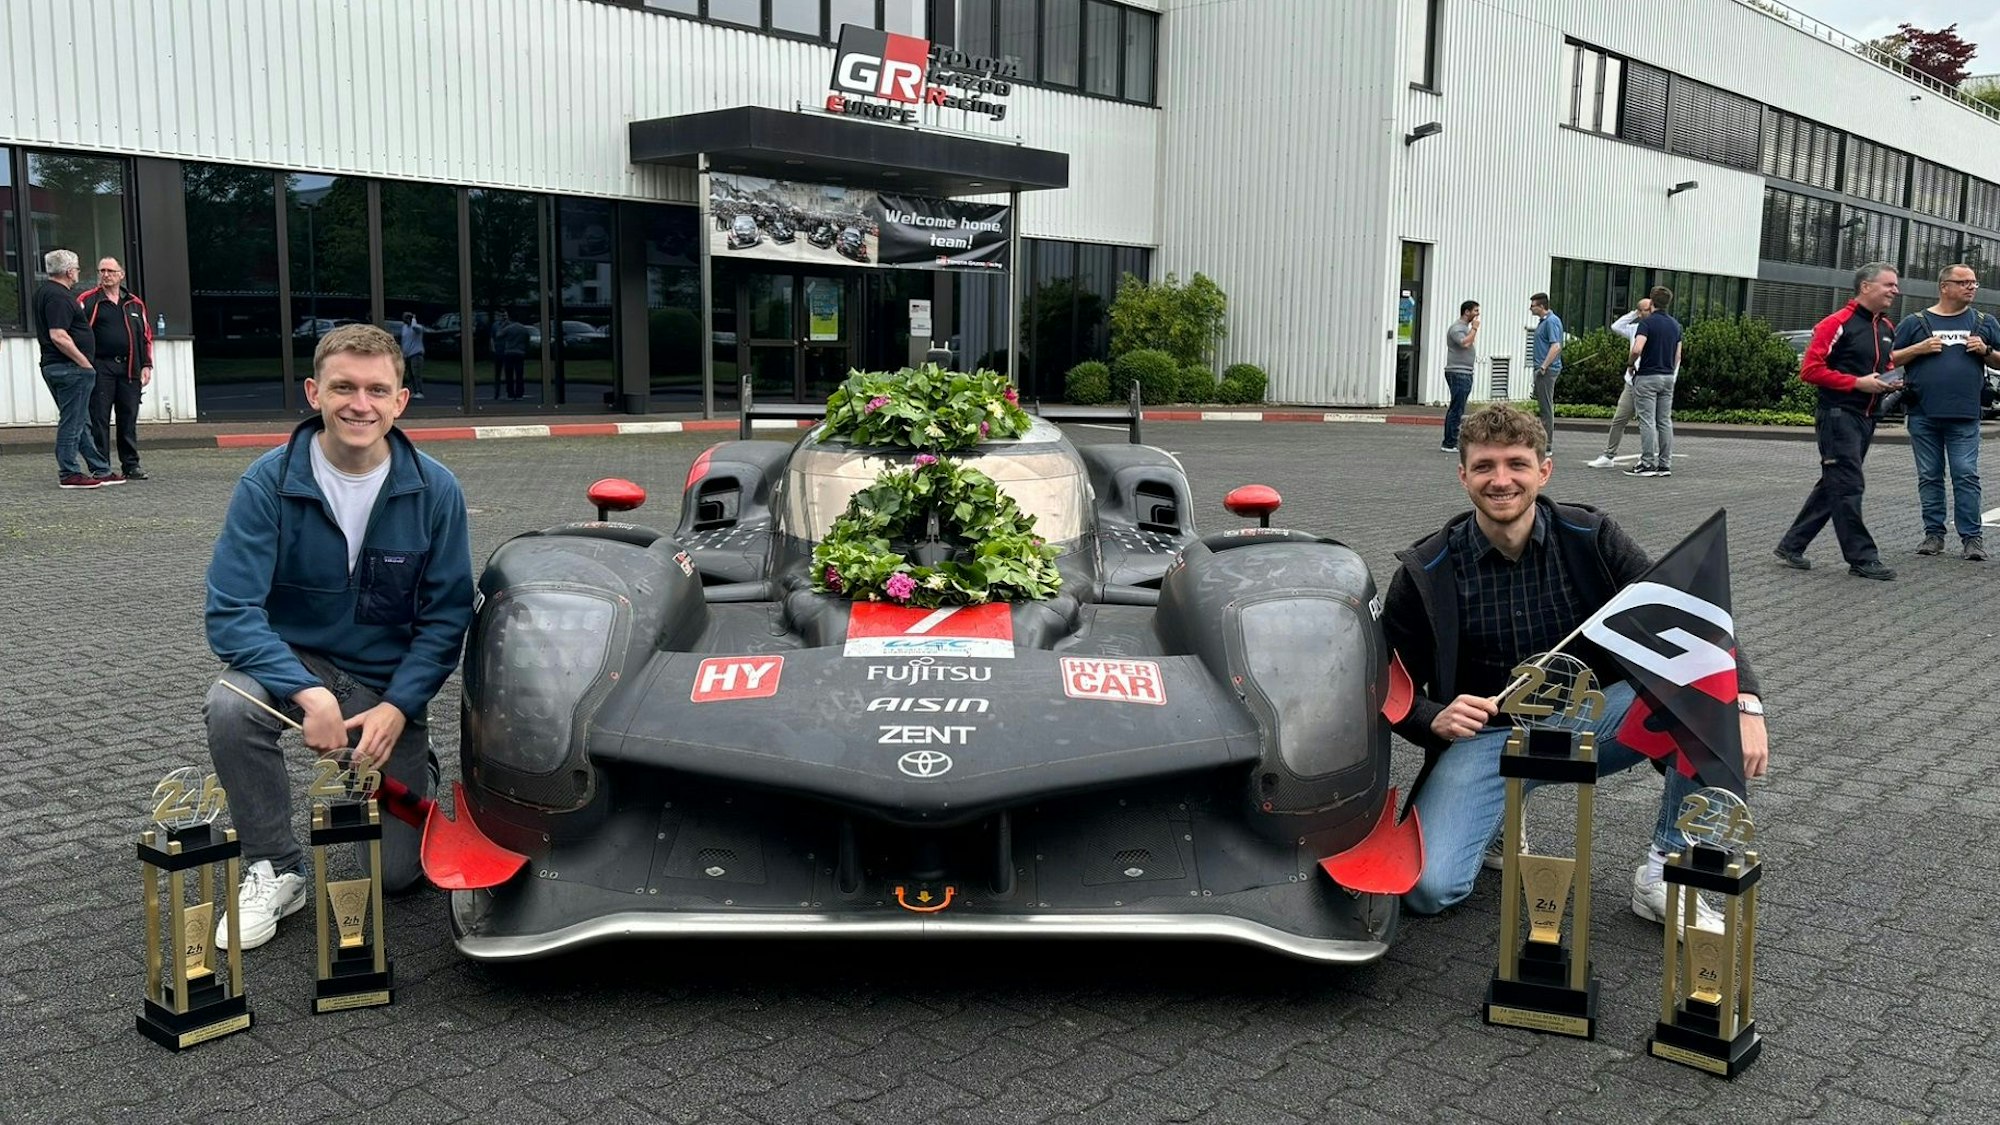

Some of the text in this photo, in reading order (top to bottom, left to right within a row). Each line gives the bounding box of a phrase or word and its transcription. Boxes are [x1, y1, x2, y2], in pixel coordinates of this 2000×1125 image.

[934, 44, 1020, 77] TOYOTA
[838, 52, 921, 101] GR
[928, 67, 1011, 97] GAZOO
[926, 87, 1007, 121] Racing
[885, 209, 1002, 233] Welcome home,
[930, 233, 974, 250] team!
[700, 662, 777, 693] HY
[867, 657, 992, 686] FUJITSU
[1069, 661, 1151, 677] HYPER
[1073, 673, 1157, 699] CAR
[867, 697, 990, 713] AISIN
[878, 725, 977, 744] ZENT
